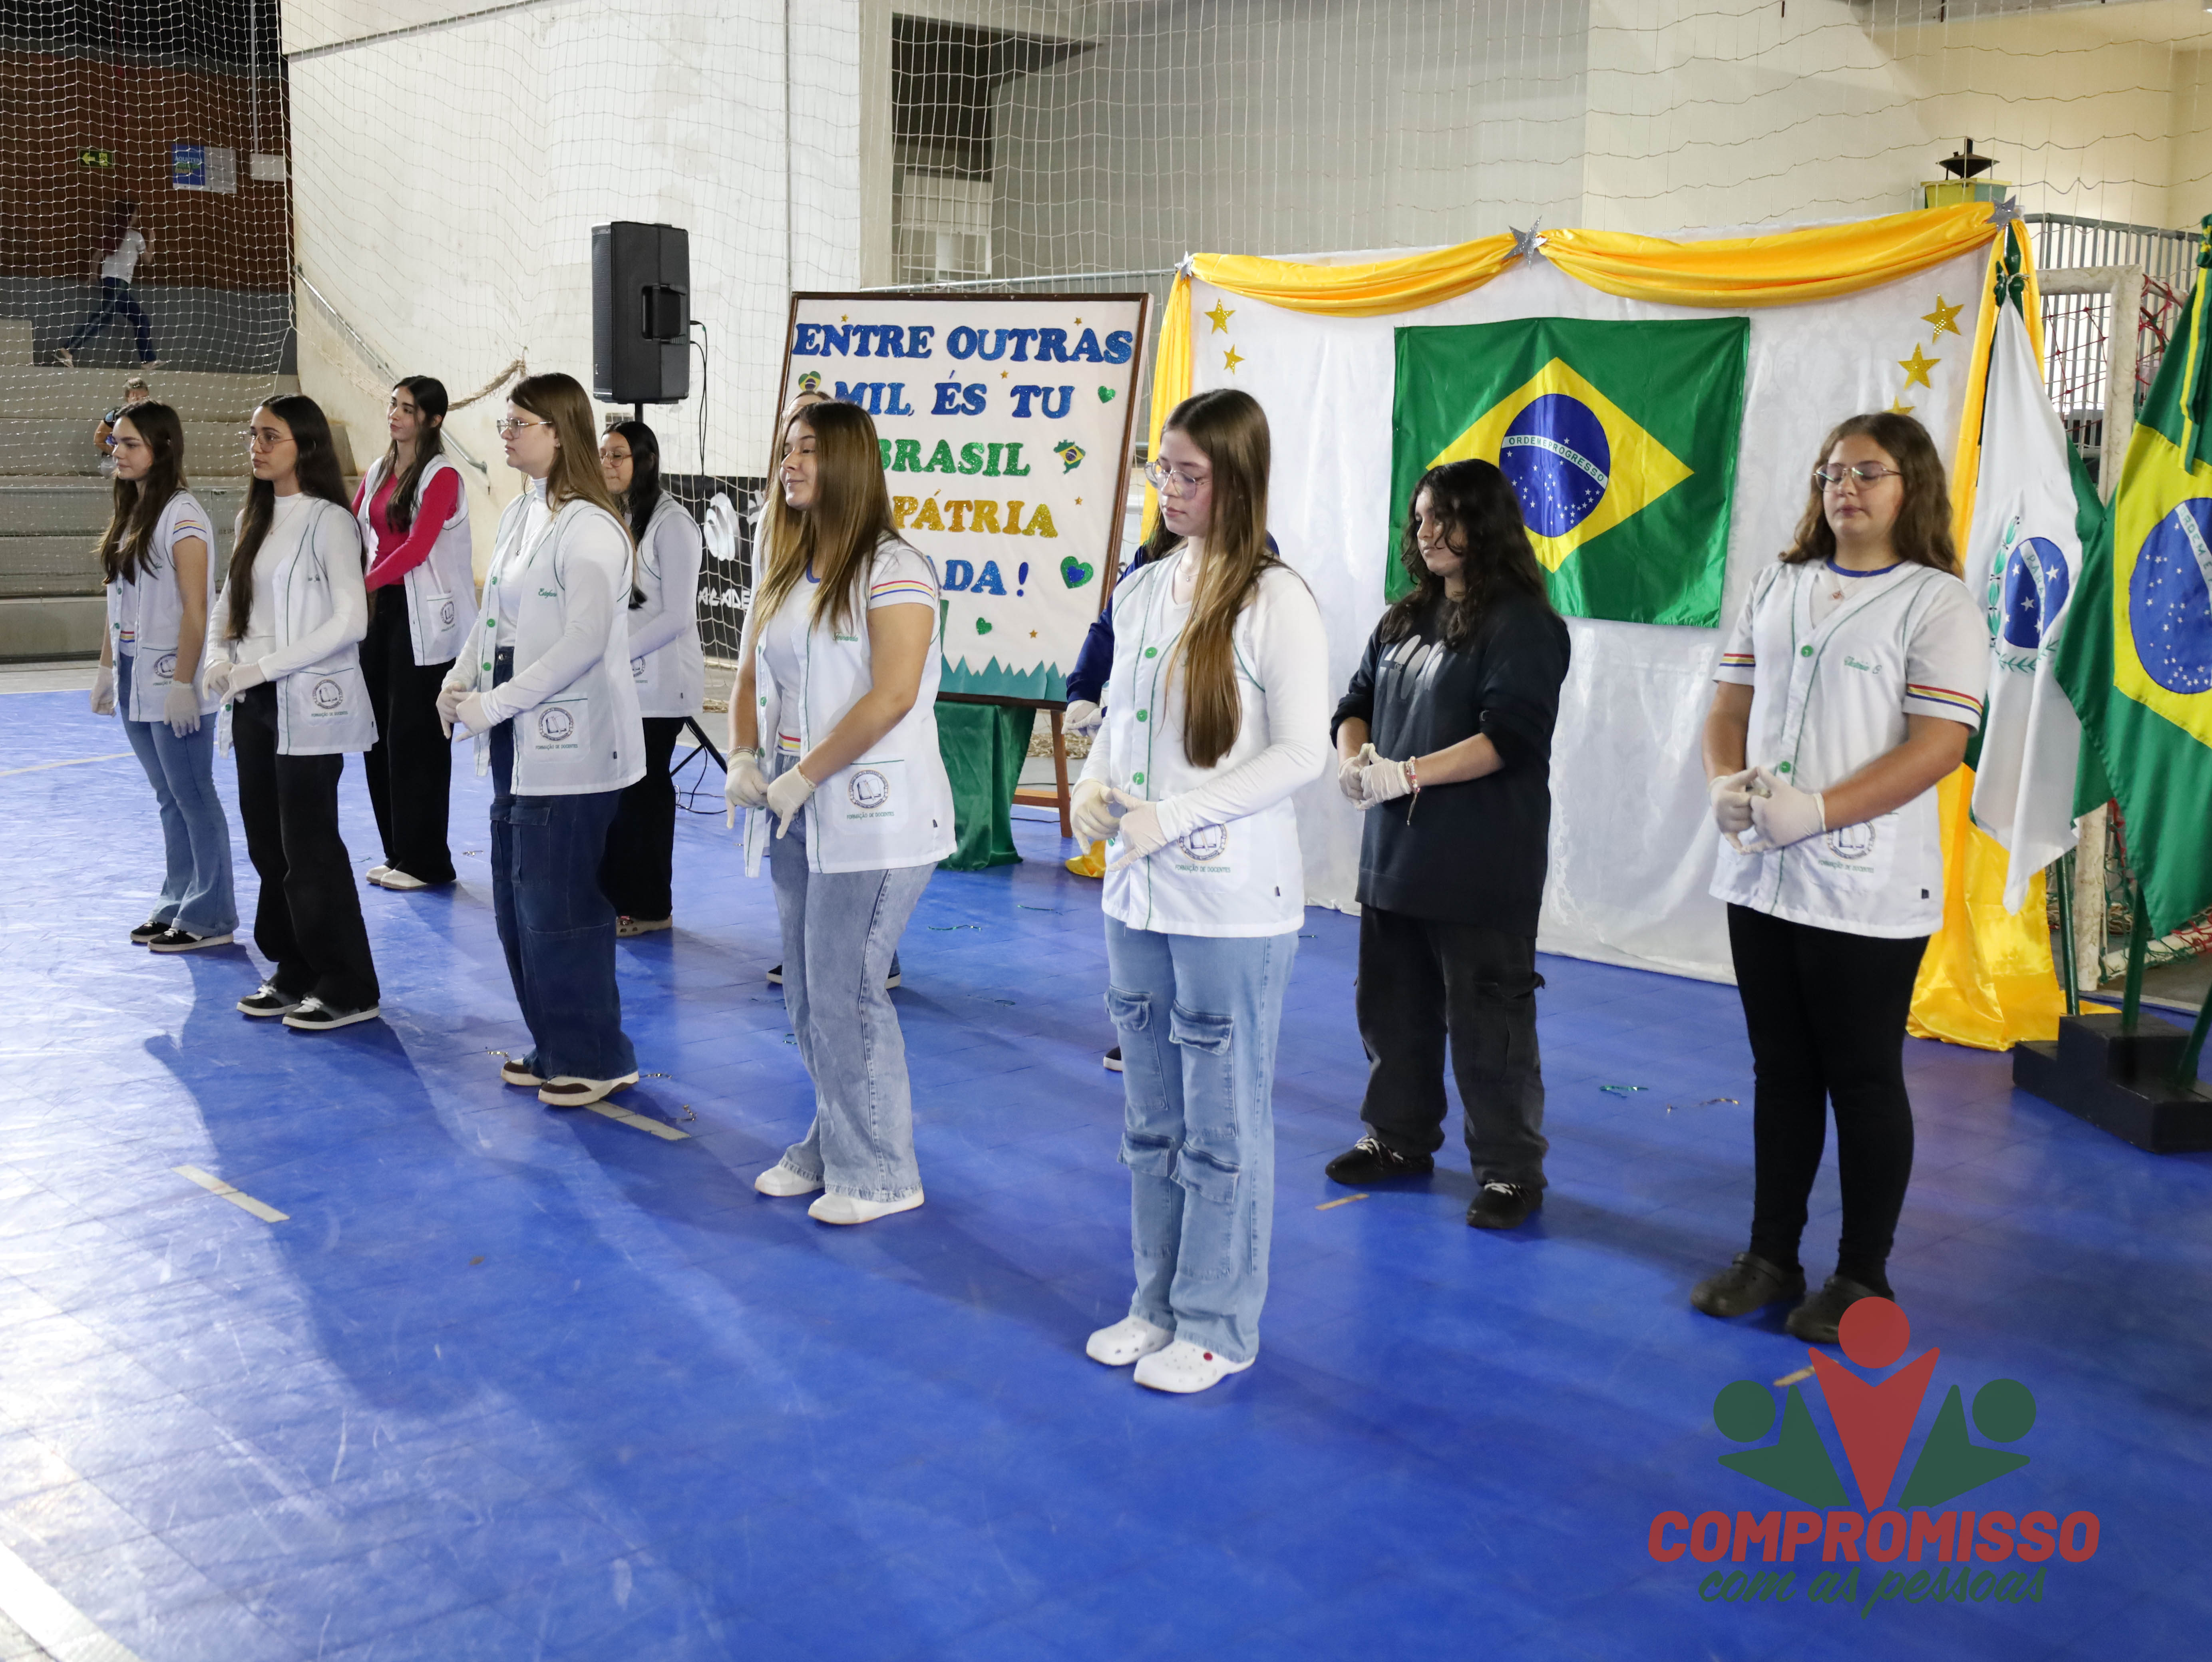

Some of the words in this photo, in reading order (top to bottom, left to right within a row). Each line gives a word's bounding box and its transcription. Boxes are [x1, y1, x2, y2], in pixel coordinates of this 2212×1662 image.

[792, 323, 934, 358] ENTRE
[947, 326, 1133, 364] OUTRAS
[931, 370, 987, 416] ÉS
[1011, 385, 1076, 419] TU
[1509, 436, 1541, 445] ORDEM
[1548, 442, 1604, 482] PROGRESSO
[893, 489, 1058, 538] PÁTRIA
[2180, 507, 2206, 556] ORDEM
[925, 555, 1029, 597] DA!
[847, 812, 867, 820] FORMAÇÃO
[1175, 864, 1198, 873] FORMAÇÃO
